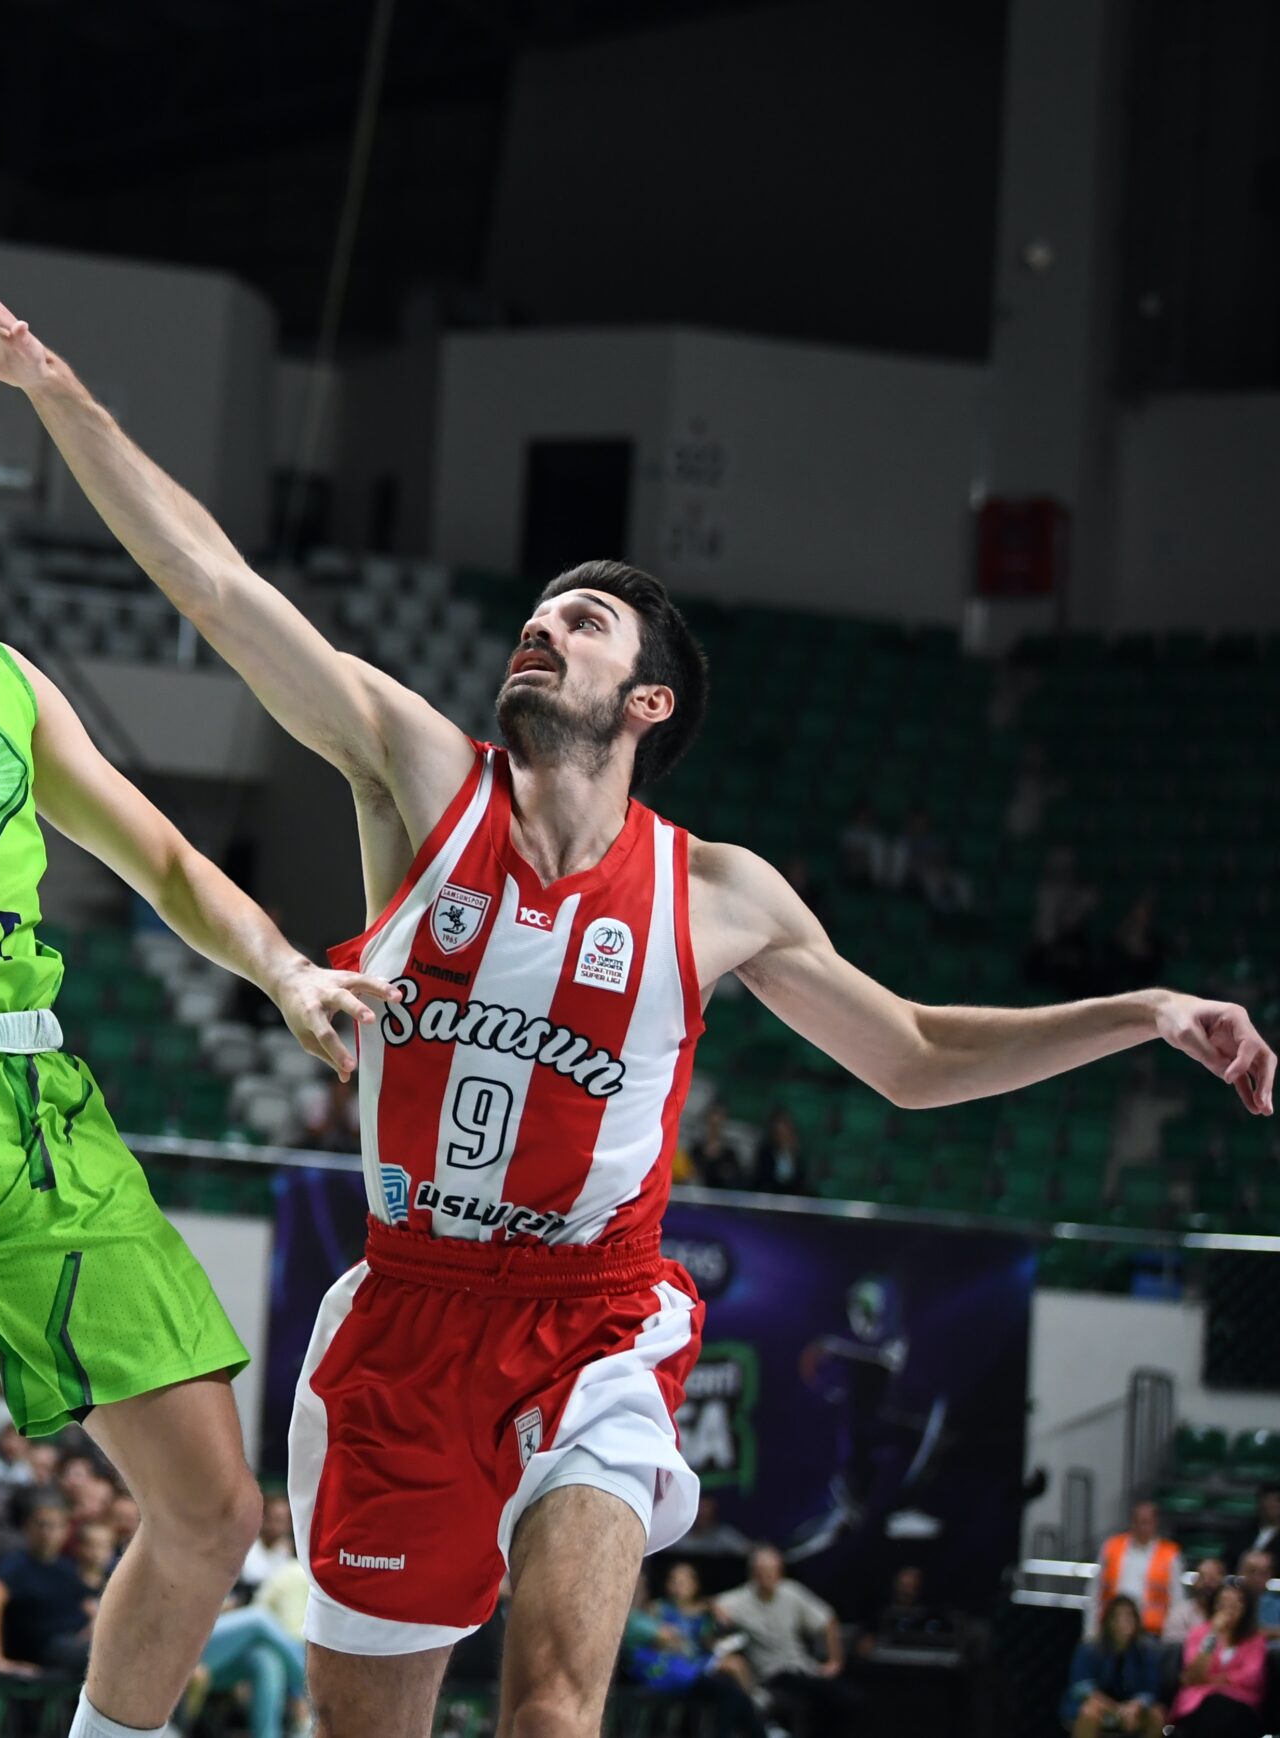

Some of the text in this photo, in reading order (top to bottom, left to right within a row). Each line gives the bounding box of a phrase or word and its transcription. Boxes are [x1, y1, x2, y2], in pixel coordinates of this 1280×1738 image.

[442, 888, 484, 906] SAMSUNSPOR
[442, 934, 458, 944] 1965
[410, 955, 471, 986] hummel
[381, 976, 626, 1098] Samsun
[447, 1076, 513, 1170] 9
[339, 1548, 406, 1571] hummel
